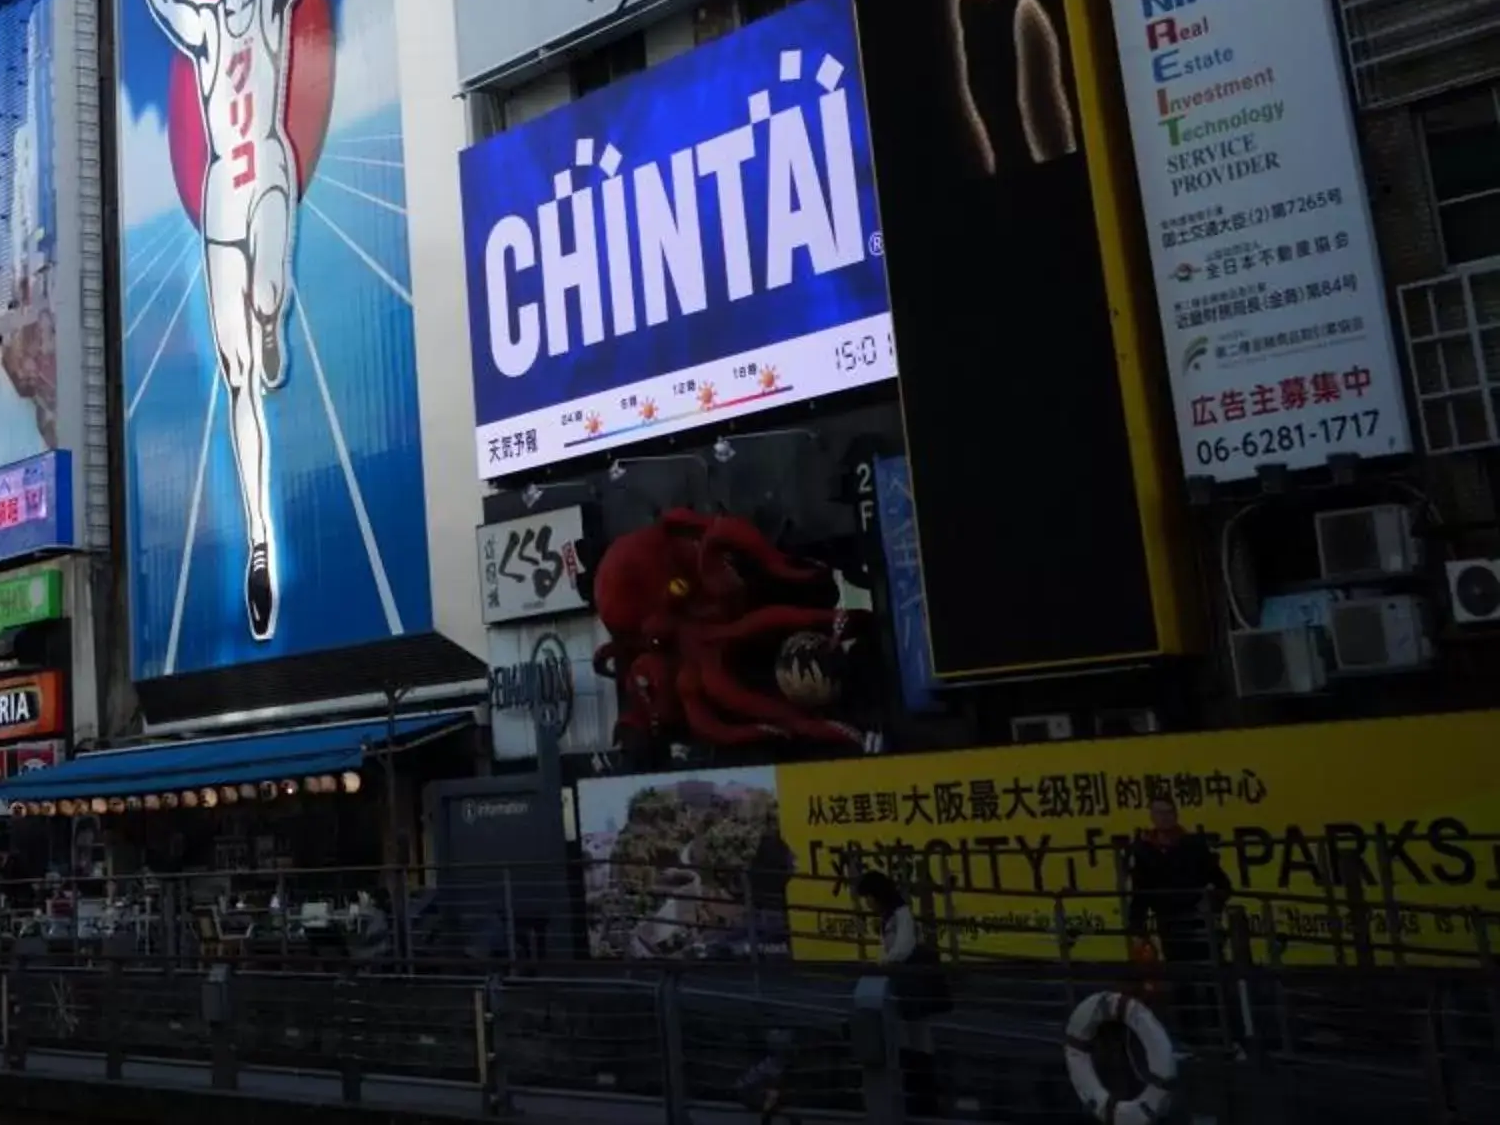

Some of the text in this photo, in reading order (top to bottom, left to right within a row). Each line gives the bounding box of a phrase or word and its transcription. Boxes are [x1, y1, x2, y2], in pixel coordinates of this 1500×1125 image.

[1145, 16, 1210, 52] Real
[1152, 45, 1235, 84] Estate
[225, 36, 257, 191] グリコ
[1156, 65, 1276, 117] Investment
[1157, 98, 1286, 148] Technology
[1165, 133, 1259, 176] SERVICE
[1169, 151, 1282, 199] PROVIDER
[484, 49, 865, 378] CHINTAI
[1190, 364, 1372, 428] 広告主募集中
[487, 429, 538, 464] 天気予報
[1196, 408, 1380, 466] 06-6281-1717
